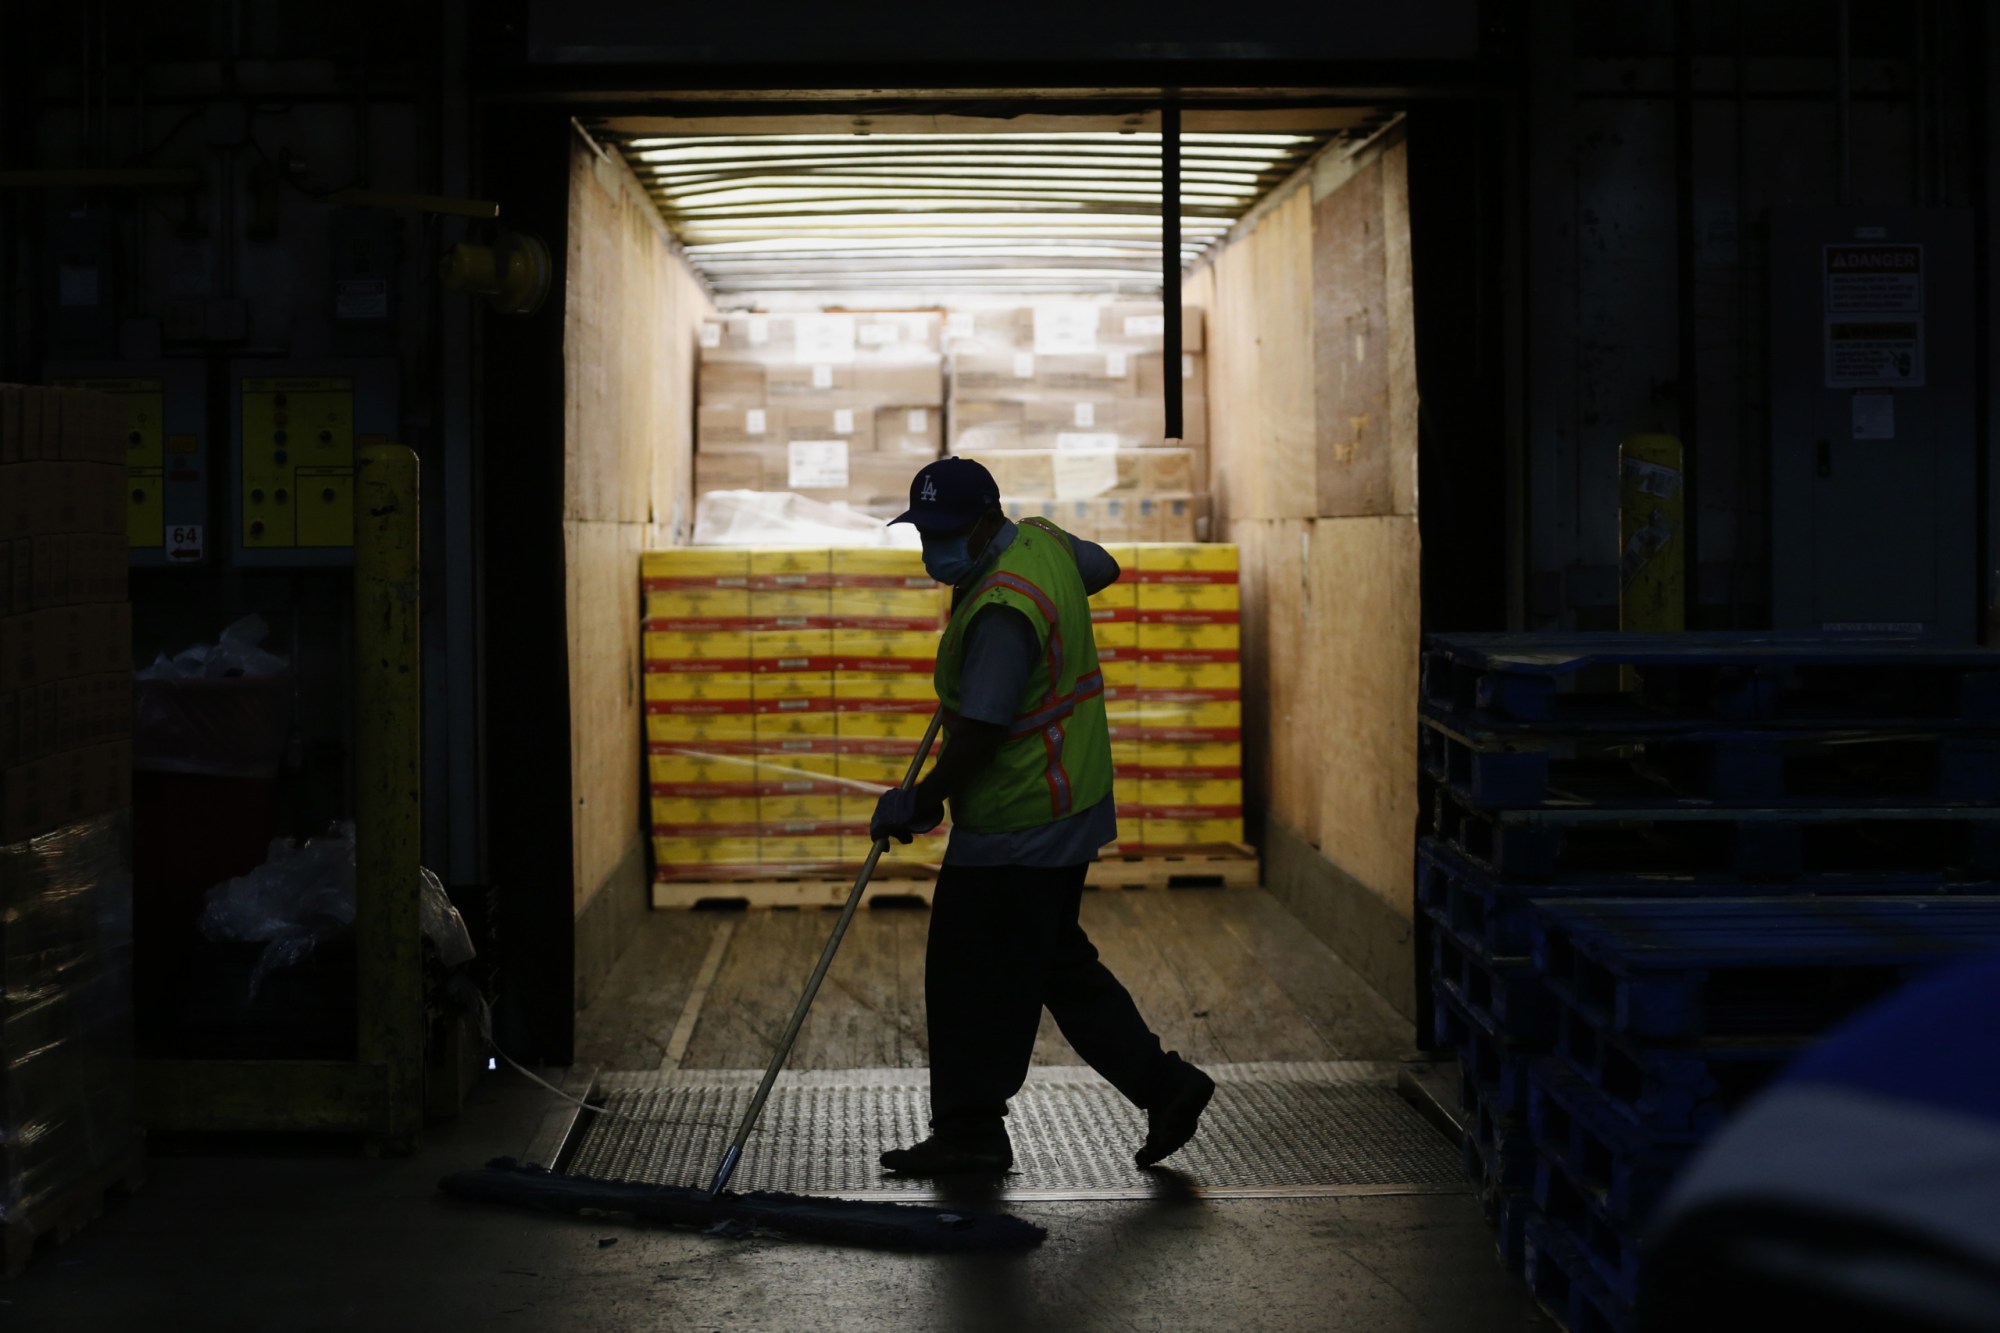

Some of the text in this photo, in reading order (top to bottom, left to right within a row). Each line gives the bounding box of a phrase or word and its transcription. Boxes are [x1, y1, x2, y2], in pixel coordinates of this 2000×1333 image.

[1848, 253, 1915, 267] DANGER
[920, 475, 937, 501] LA
[174, 527, 197, 544] 64
